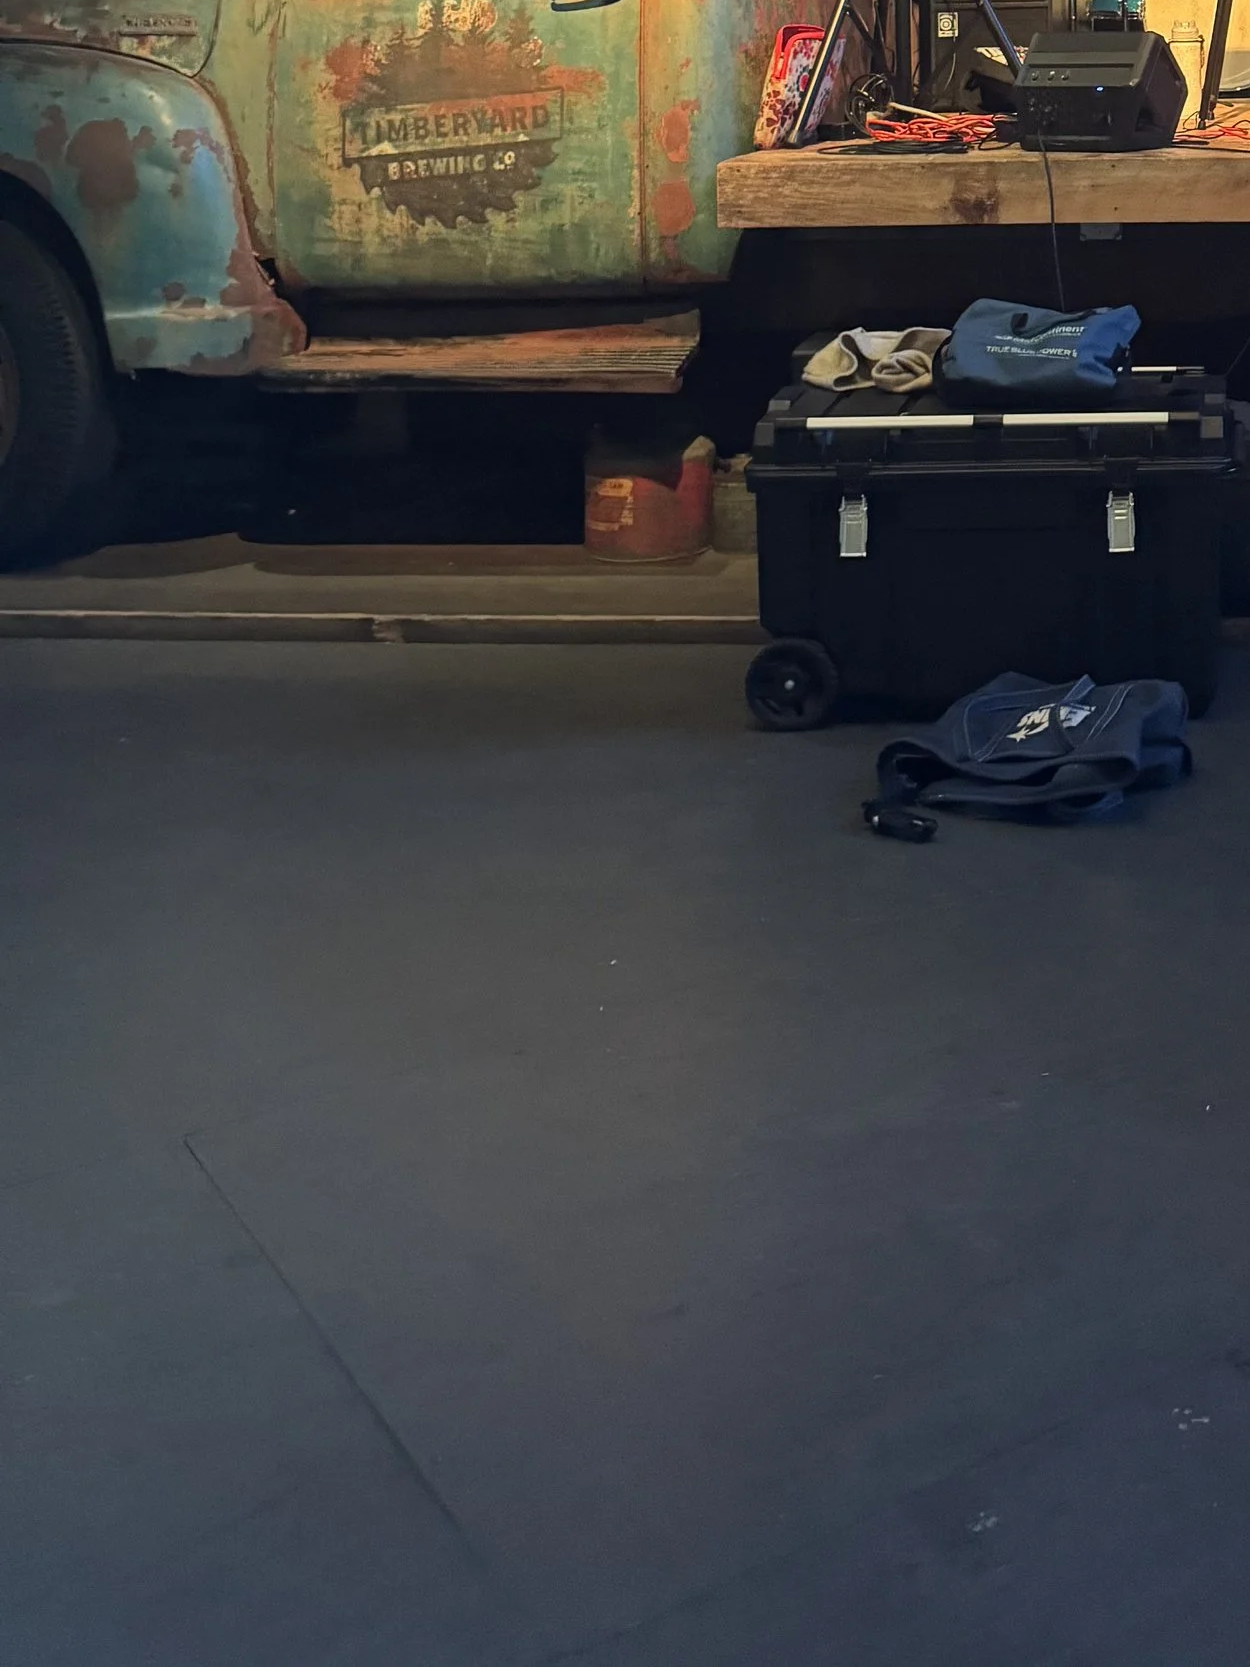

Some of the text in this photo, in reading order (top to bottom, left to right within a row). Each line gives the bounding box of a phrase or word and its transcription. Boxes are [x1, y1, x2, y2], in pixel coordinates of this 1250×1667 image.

[352, 102, 550, 146] TIMBERYARD
[386, 153, 488, 181] BREWING
[986, 345, 1010, 353] TRUE
[1038, 347, 1072, 356] OWER
